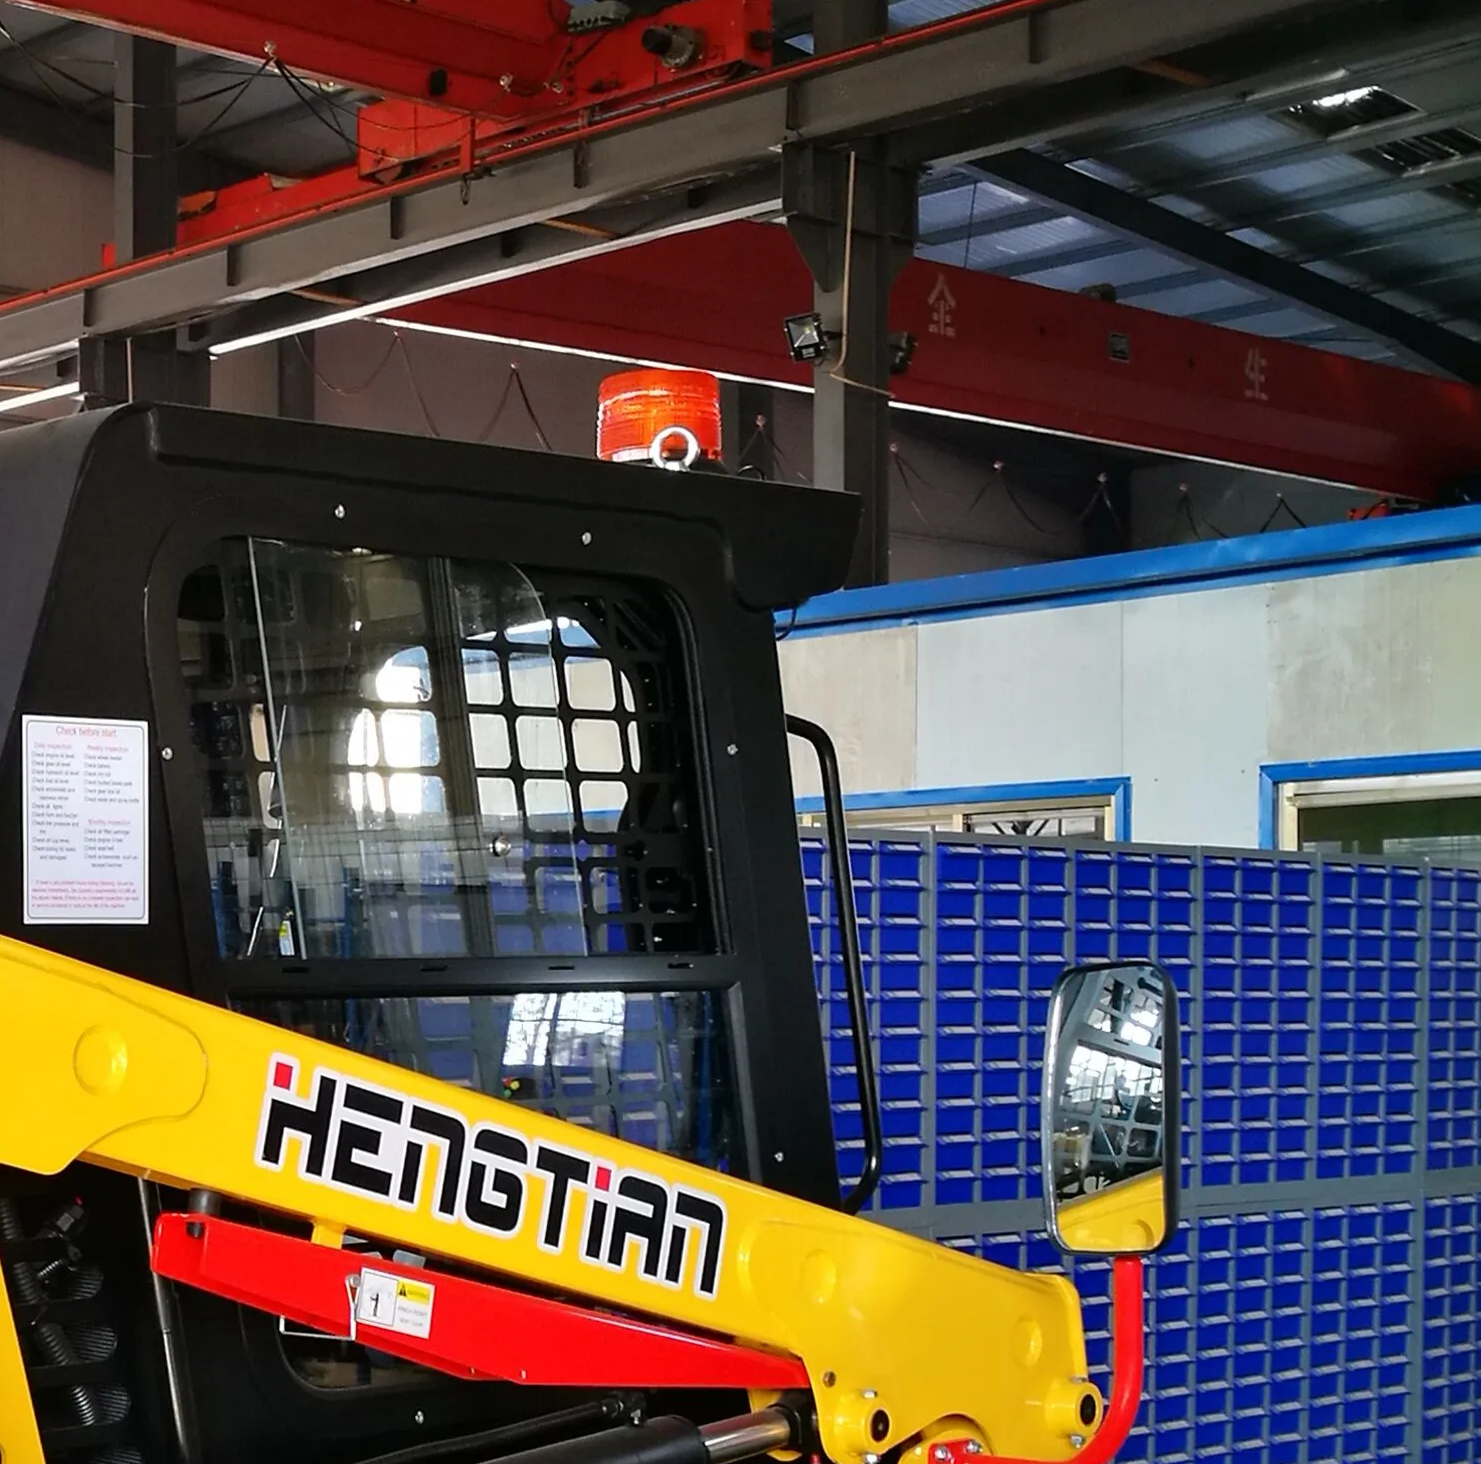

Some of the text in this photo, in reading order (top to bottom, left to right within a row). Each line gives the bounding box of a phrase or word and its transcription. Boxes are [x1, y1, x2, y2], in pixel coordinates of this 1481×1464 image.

[928, 273, 1269, 400] 金 生
[56, 725, 116, 738] Check before start
